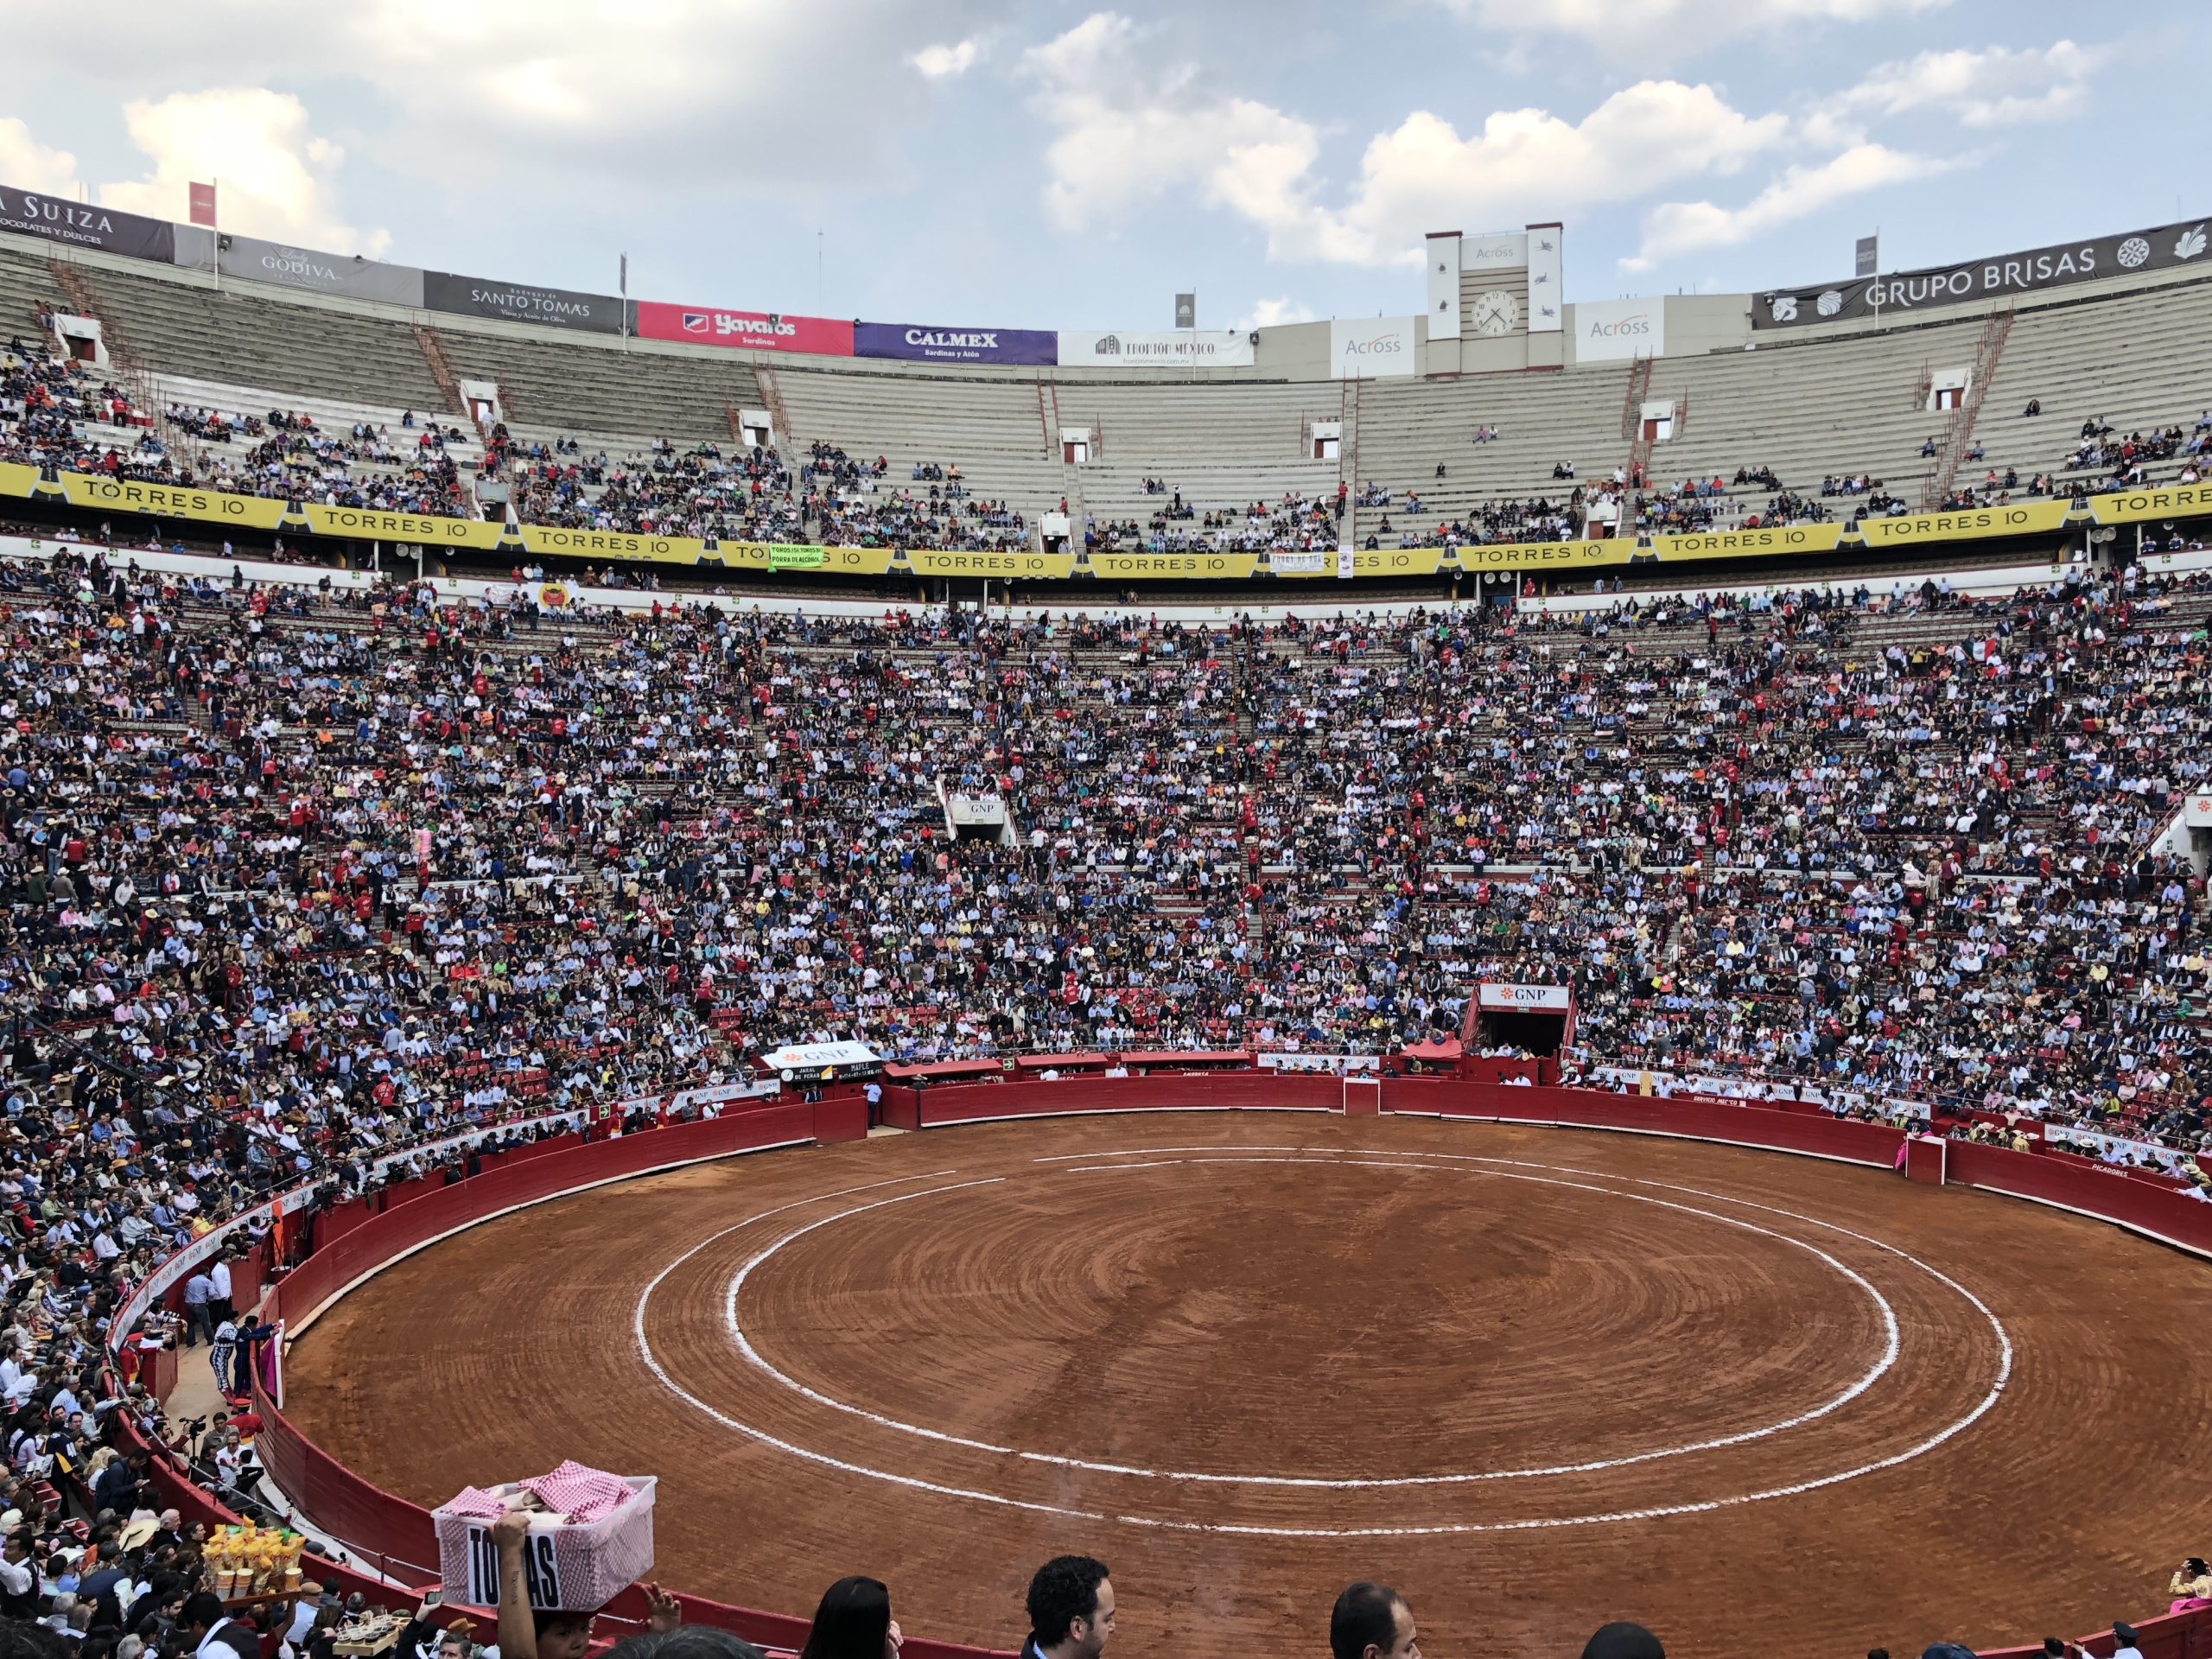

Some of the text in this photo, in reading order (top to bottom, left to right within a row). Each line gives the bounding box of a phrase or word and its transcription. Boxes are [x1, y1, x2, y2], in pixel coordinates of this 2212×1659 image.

[24, 195, 113, 233] SUIZA
[63, 230, 102, 245] DULCES
[1476, 245, 1514, 260] Across
[262, 256, 336, 281] GODIVA
[1865, 248, 2096, 307] GRUPO BRISAS
[472, 289, 528, 308] SANTO
[1591, 317, 1649, 338] Across
[742, 337, 775, 346] Sardinas
[905, 328, 999, 348] CALMEX
[1345, 336, 1402, 355] Across
[84, 480, 245, 514] TORRES 10
[325, 512, 467, 537] TORRES 10
[1879, 511, 2028, 536] TORRES 10
[539, 531, 670, 553] TORRES 10
[1671, 531, 1805, 551] TORRES 10
[842, 553, 861, 564] 10
[1392, 555, 1409, 567] 10
[1475, 545, 1602, 563] TORRES 10
[925, 556, 1044, 569] TORRES 10
[1106, 558, 1225, 570] TORRES 10
[971, 804, 995, 813] GNP
[1515, 988, 1546, 1001] GNP
[804, 1049, 849, 1060] GNP
[851, 1062, 869, 1072] MAPLE
[2113, 1141, 2127, 1149] GNP
[2091, 1163, 2129, 1178] PICADORES
